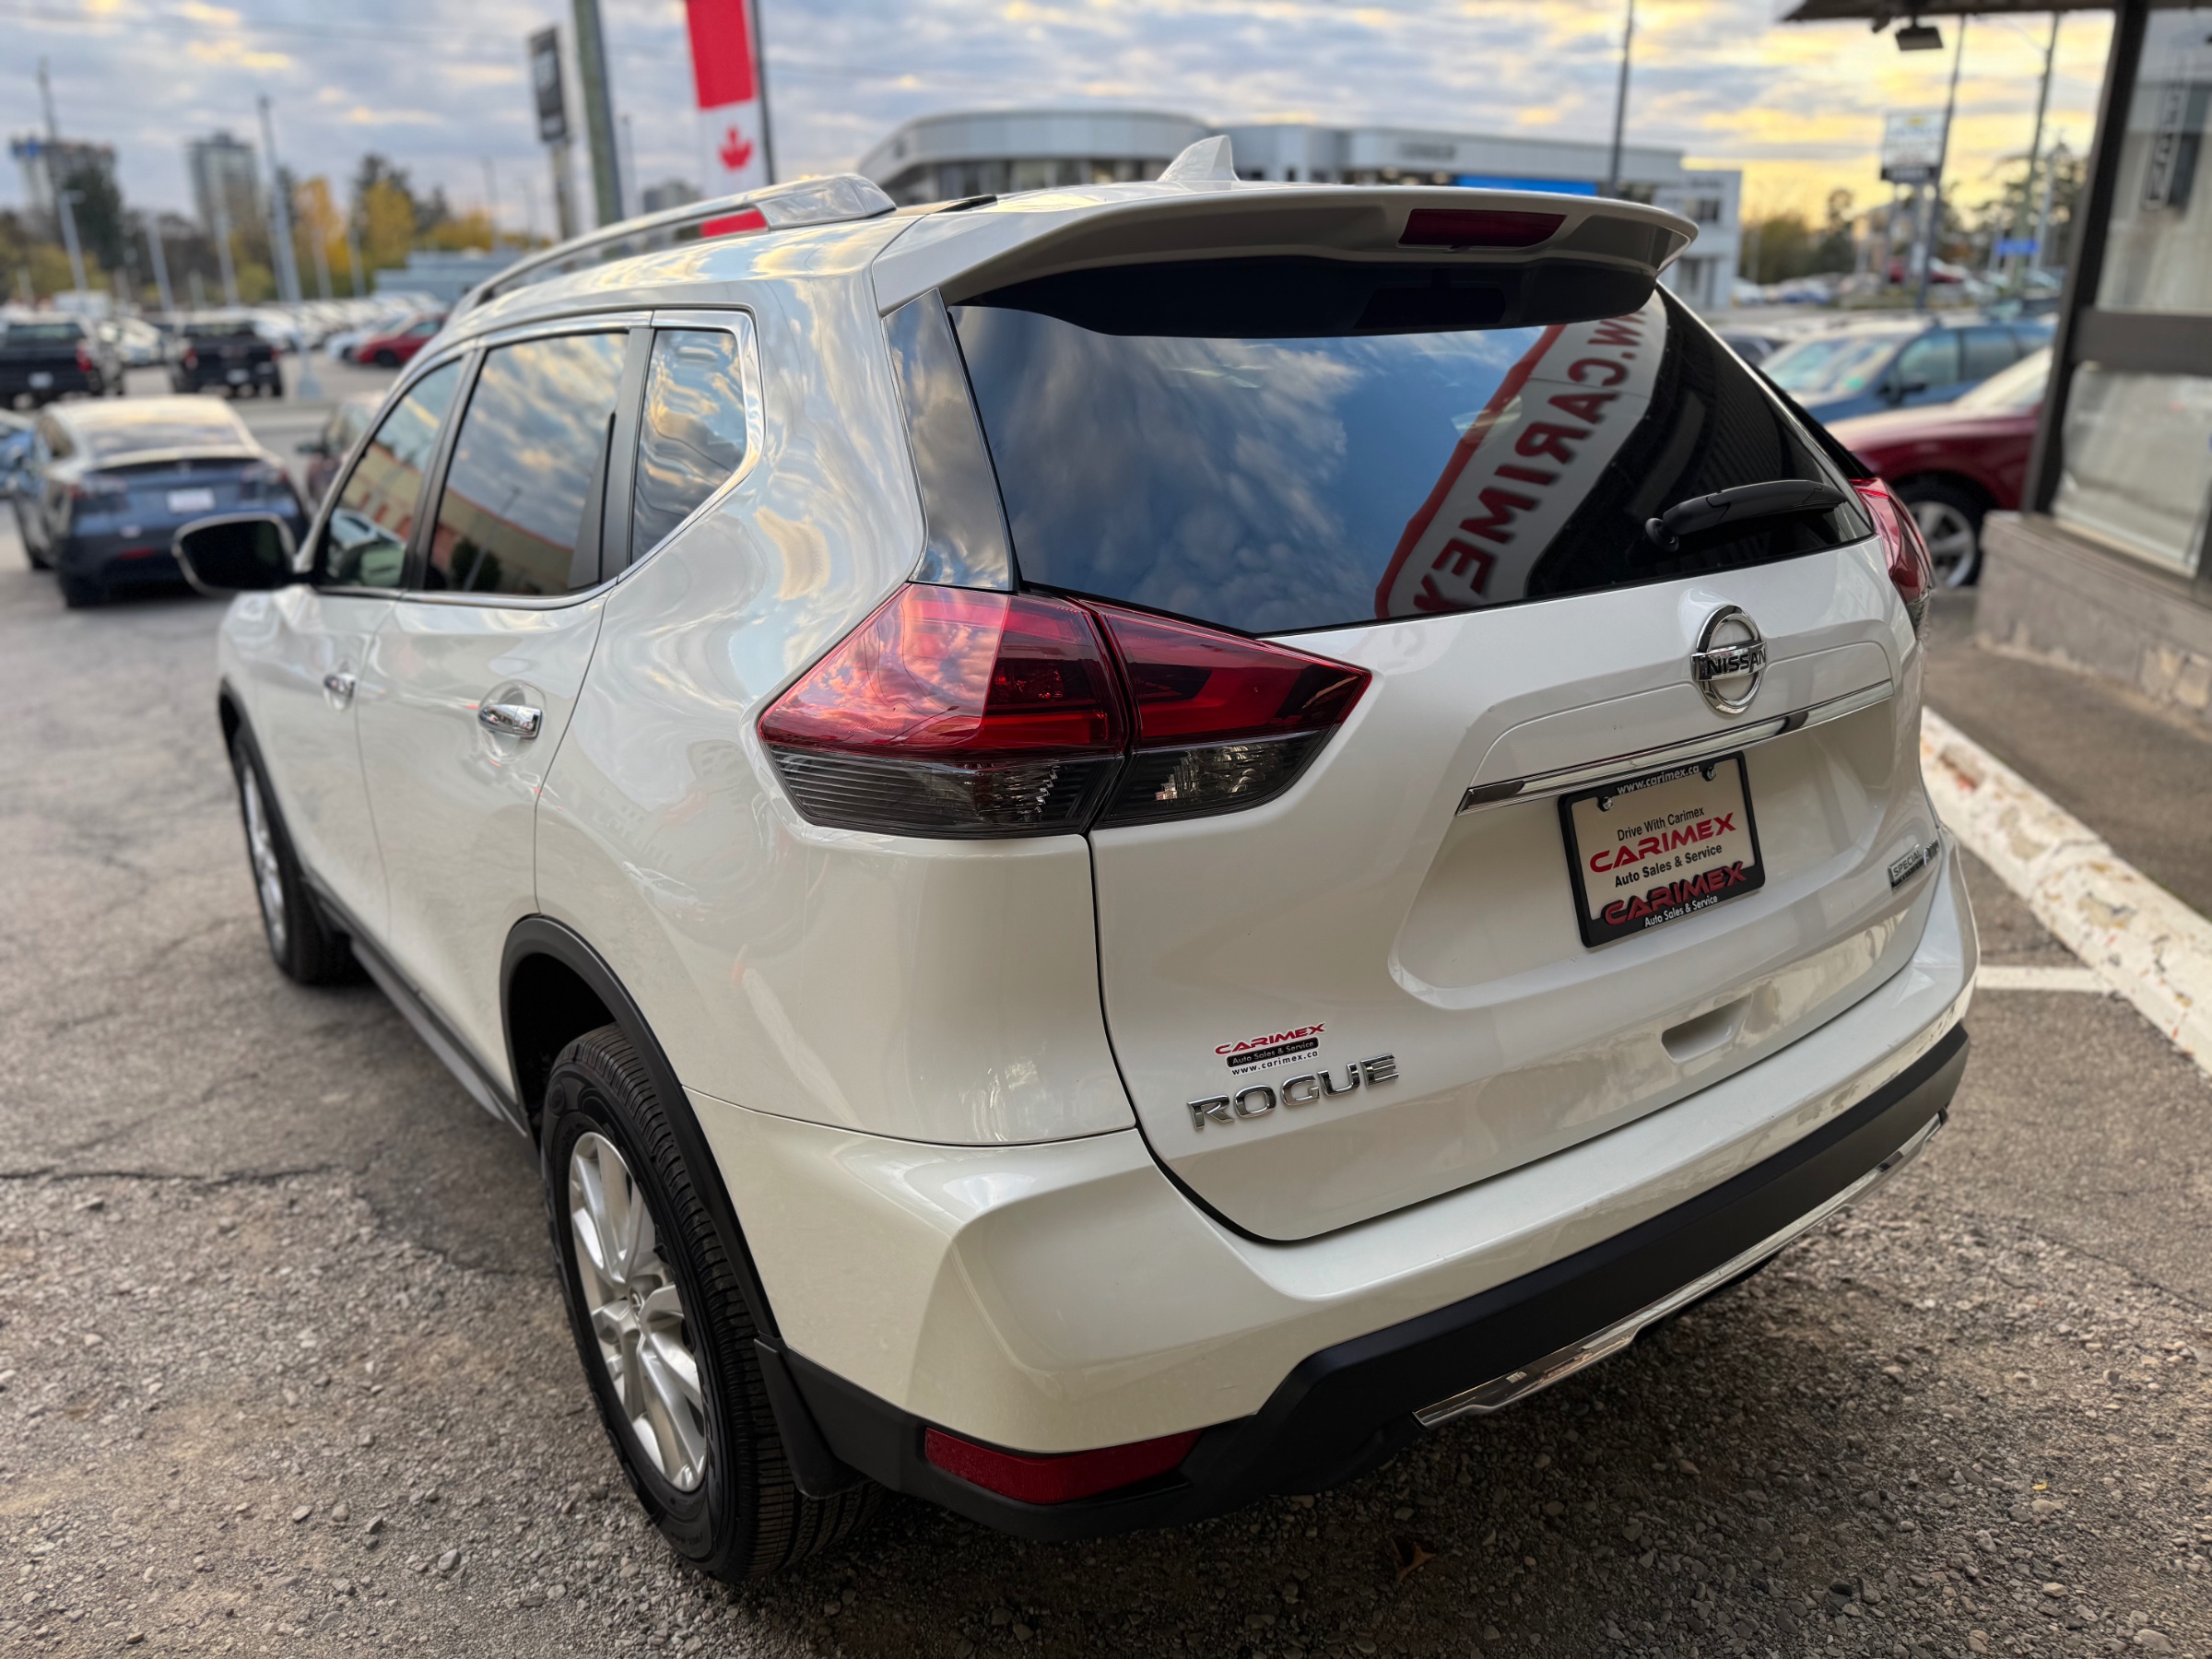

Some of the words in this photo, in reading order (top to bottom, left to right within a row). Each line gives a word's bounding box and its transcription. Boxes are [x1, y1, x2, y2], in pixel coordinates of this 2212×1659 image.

[1706, 647, 1767, 675] NISSAN
[1617, 764, 1700, 795] www.carimex.ca
[1617, 826, 1642, 841] Drive
[1643, 818, 1666, 833] With
[1667, 806, 1705, 826] Carimex
[1589, 812, 1736, 873] CARIMEX
[1615, 871, 1641, 888] Auto
[1642, 860, 1672, 878] Sales
[1674, 856, 1684, 868] &
[1685, 844, 1723, 865] Service
[1892, 849, 1923, 877] SPECIAL
[1604, 861, 1747, 925] CARIMEX
[1644, 913, 1663, 927] Auto
[1663, 906, 1685, 920] Sales
[1685, 902, 1691, 913] &
[1692, 894, 1718, 911] Service
[1215, 1023, 1325, 1054] CARIMEX
[1231, 1054, 1253, 1065] Auto
[1253, 1051, 1276, 1061] Sales
[1277, 1047, 1284, 1055] &
[1286, 1041, 1314, 1053] Service
[1231, 1051, 1319, 1077] www.carimex.ca
[1187, 1053, 1399, 1132] ROGUE
